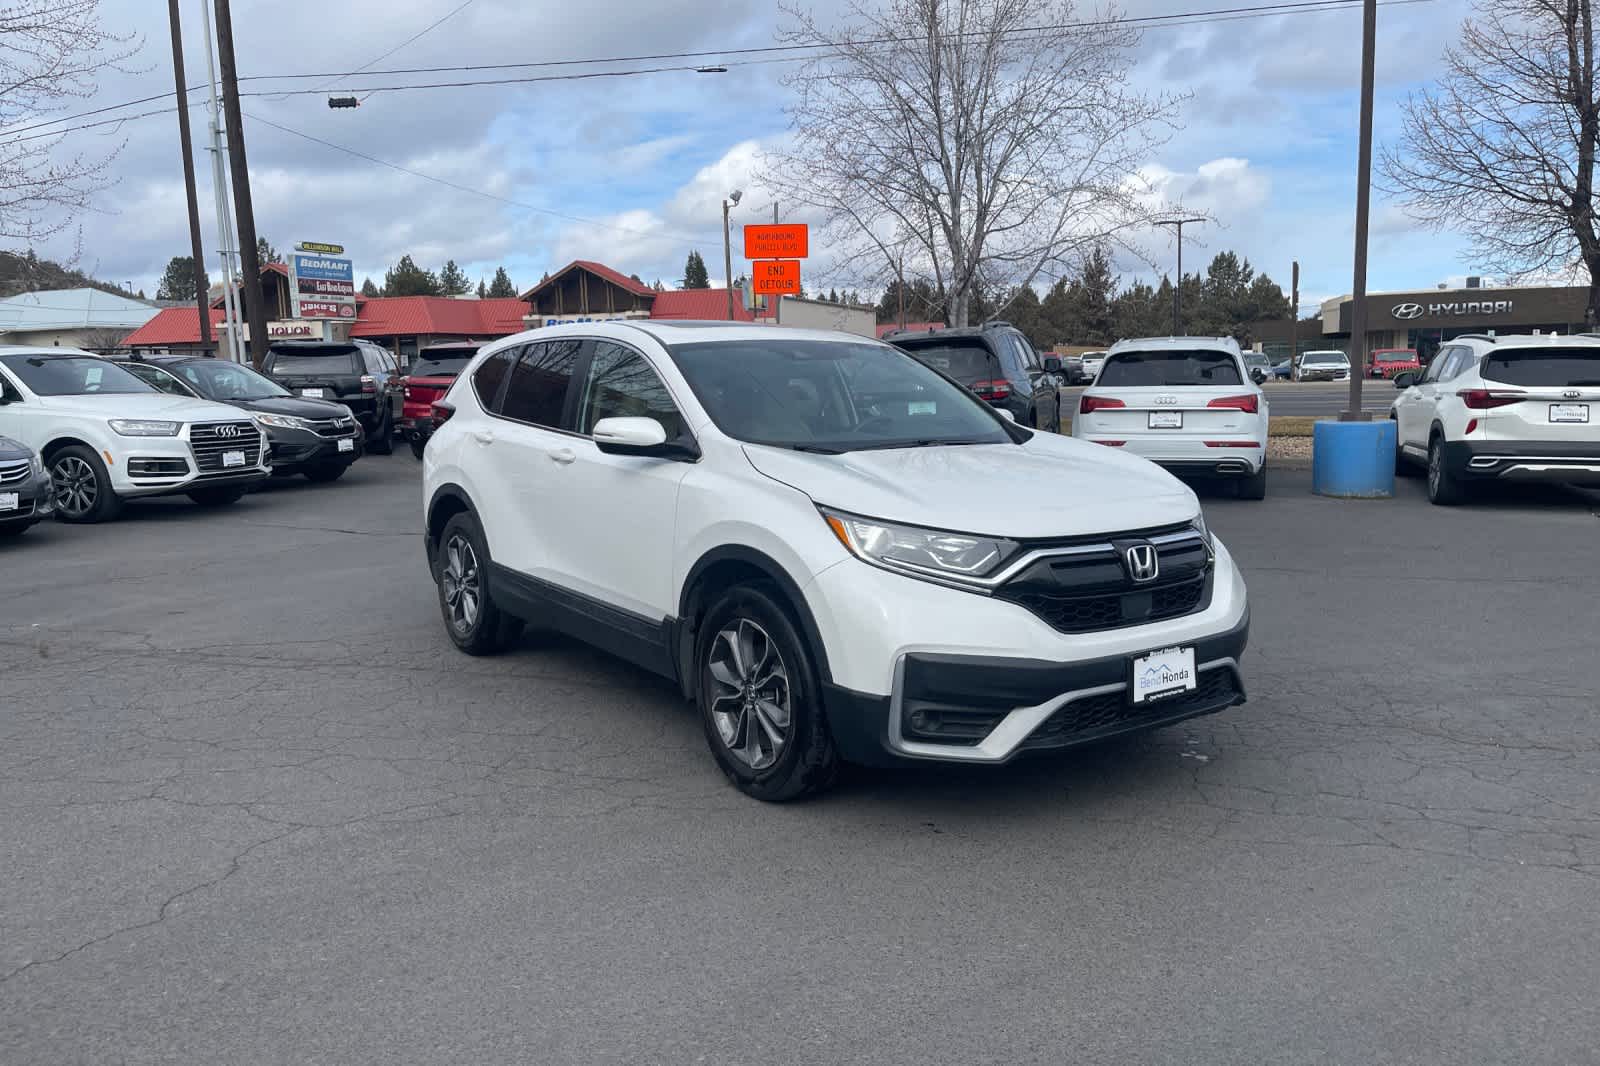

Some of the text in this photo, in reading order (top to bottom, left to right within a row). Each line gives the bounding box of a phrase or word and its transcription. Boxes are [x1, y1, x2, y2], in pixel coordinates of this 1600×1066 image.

[768, 265, 784, 275] END
[760, 279, 793, 289] DETOUR
[1428, 300, 1513, 315] HYUNDAI
[268, 326, 312, 337] IQUOR
[1162, 668, 1188, 683] Honda
